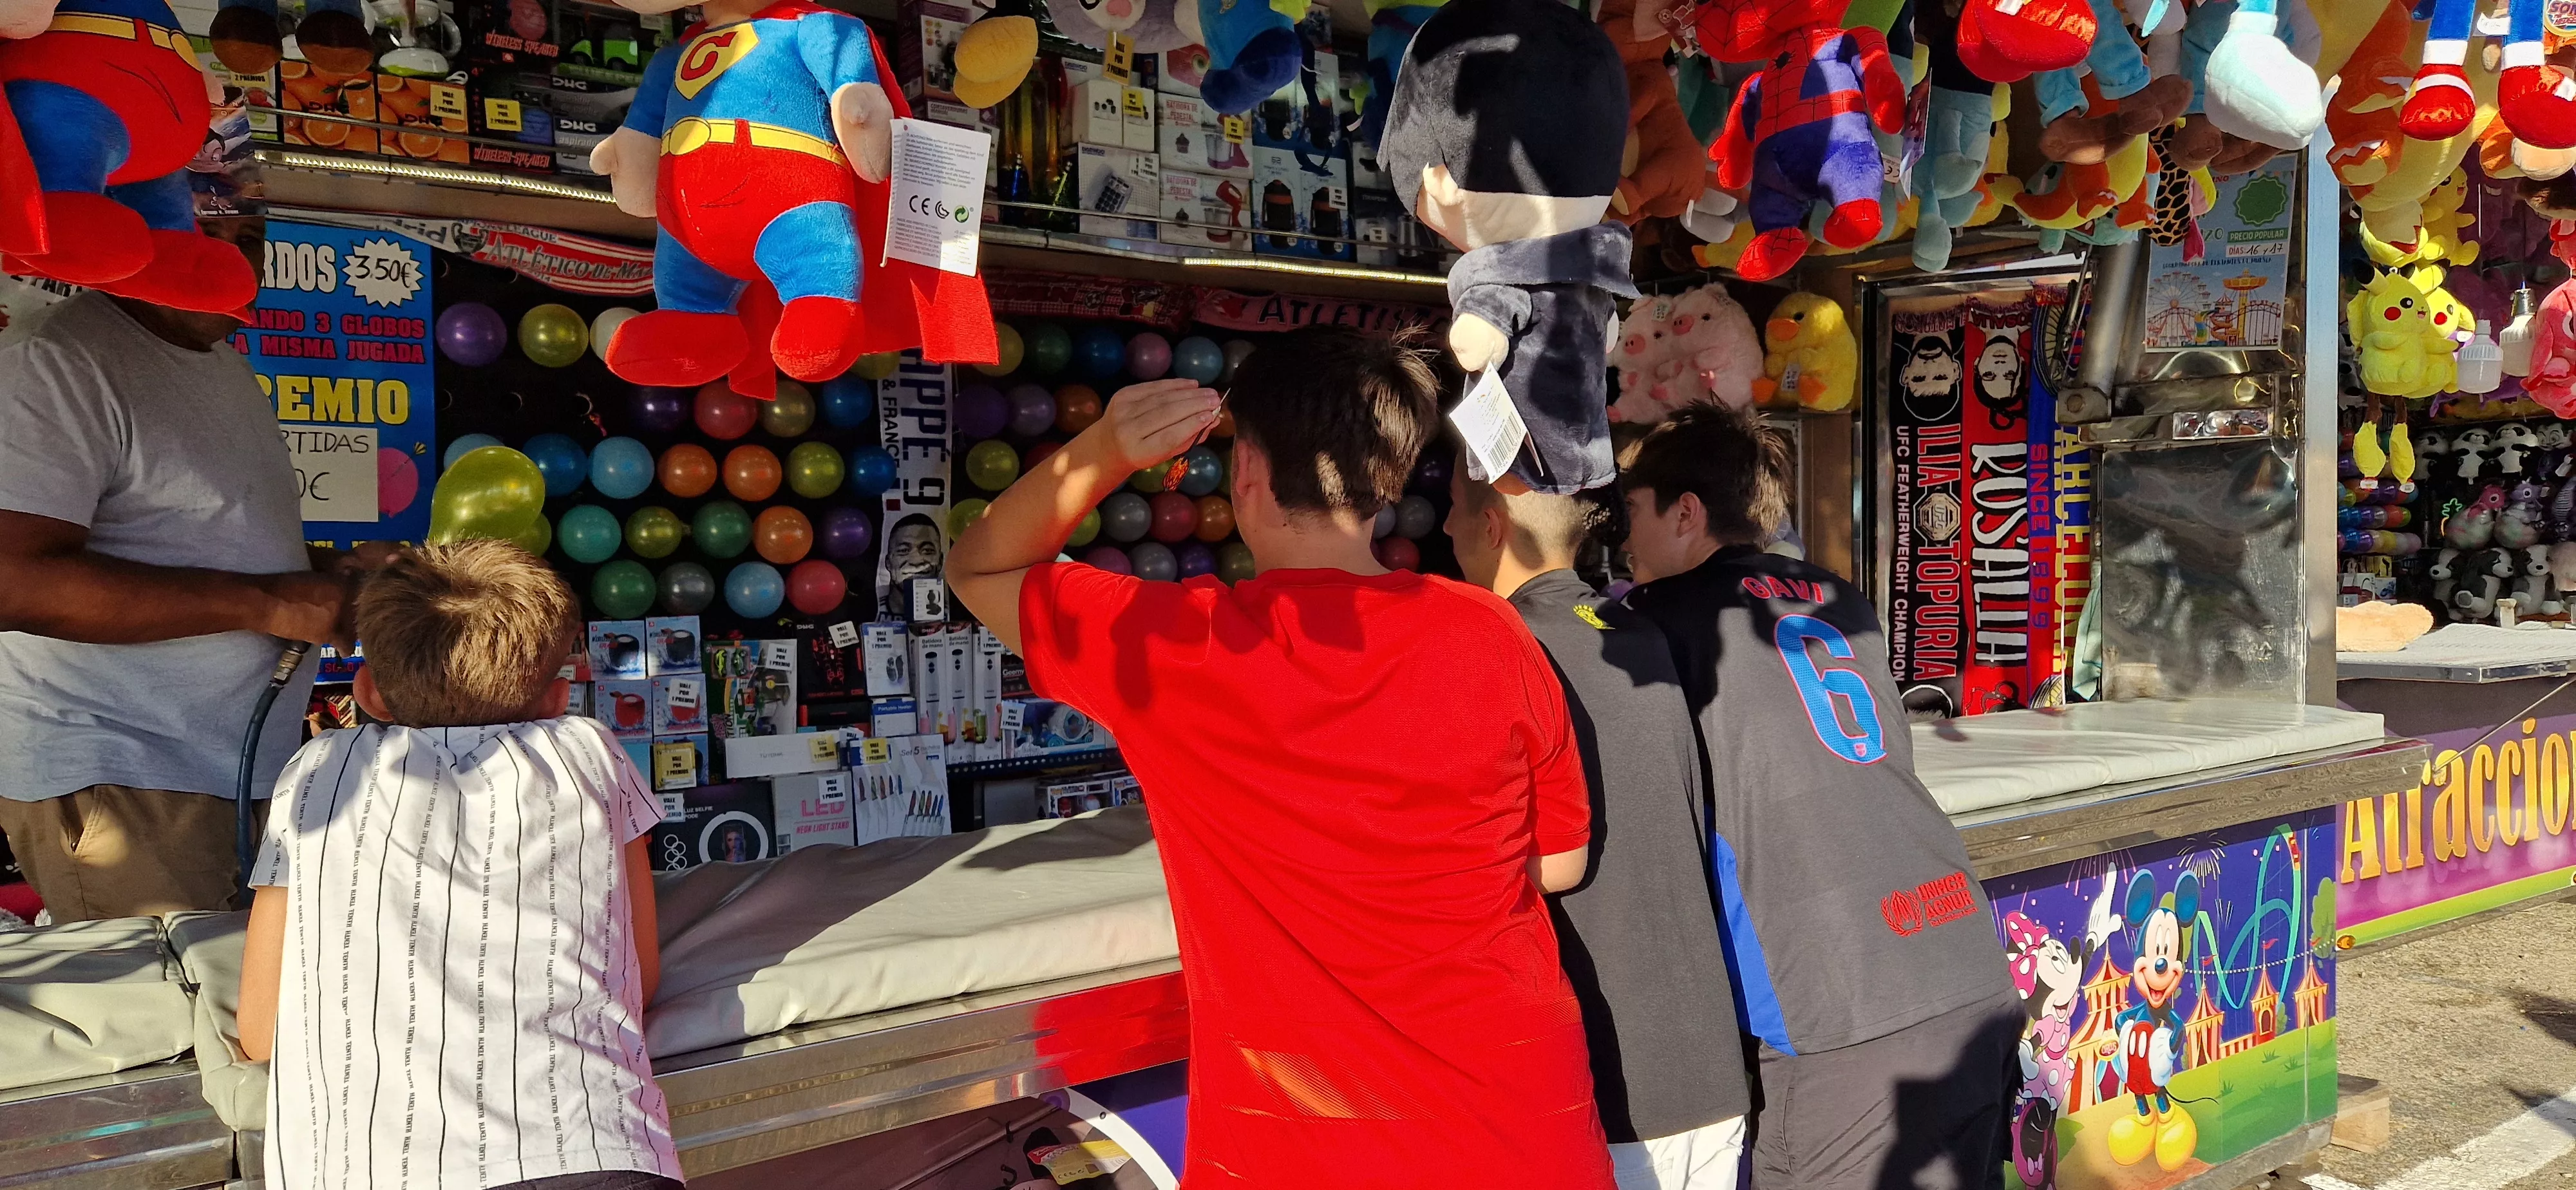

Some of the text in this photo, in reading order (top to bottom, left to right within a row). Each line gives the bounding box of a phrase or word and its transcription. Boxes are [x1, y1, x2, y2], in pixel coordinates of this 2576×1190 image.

[2230, 229, 2284, 241] PRECIO POPULAR
[2246, 245, 2259, 255] 16
[2269, 242, 2284, 254] 17
[316, 313, 330, 333] 3
[341, 314, 425, 339] GLOBOS
[261, 335, 426, 364] MISMA JUGADA
[882, 379, 896, 391] &
[903, 477, 945, 505] 9
[2030, 443, 2050, 628] SINCE 1899
[1891, 426, 1911, 682] UFC FEATHERWEIGHT CHAMPION
[1913, 422, 1961, 681] ILIA TOPURIA
[1741, 575, 1825, 604] GAVI
[1774, 612, 1888, 766] 6
[612, 751, 625, 765] TENTH
[913, 746, 920, 755] 5
[309, 768, 317, 784] TENTH
[273, 789, 290, 801] TENTH
[359, 816, 368, 832] TENTH
[630, 818, 640, 835] TENTH
[796, 821, 850, 835] NEON LIGHT STAND
[1915, 871, 1968, 902] UNHCR
[1924, 889, 1975, 920] ACNUR
[343, 930, 352, 950] TENTH
